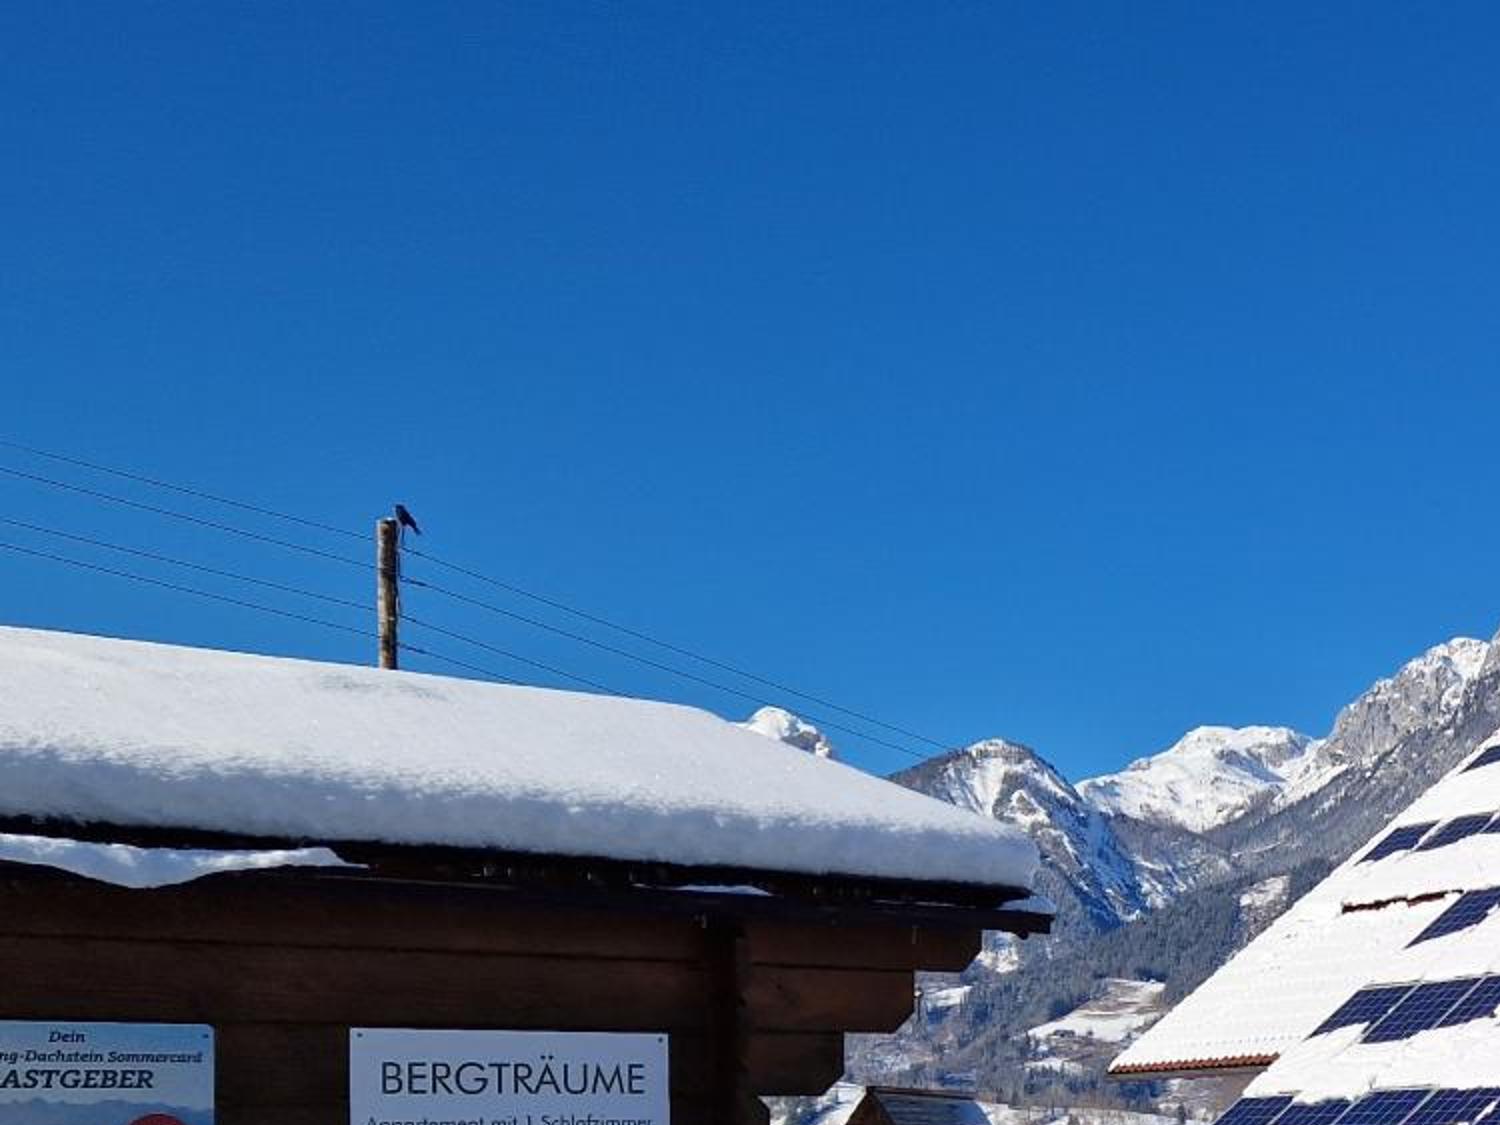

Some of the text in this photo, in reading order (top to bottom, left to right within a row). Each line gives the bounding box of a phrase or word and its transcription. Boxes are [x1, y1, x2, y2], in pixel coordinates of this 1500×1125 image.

[48, 1030, 86, 1043] Dein
[107, 1051, 203, 1064] Sommercard
[0, 1069, 154, 1089] ASTGEBER
[381, 1055, 645, 1095] BERGTRÄUME
